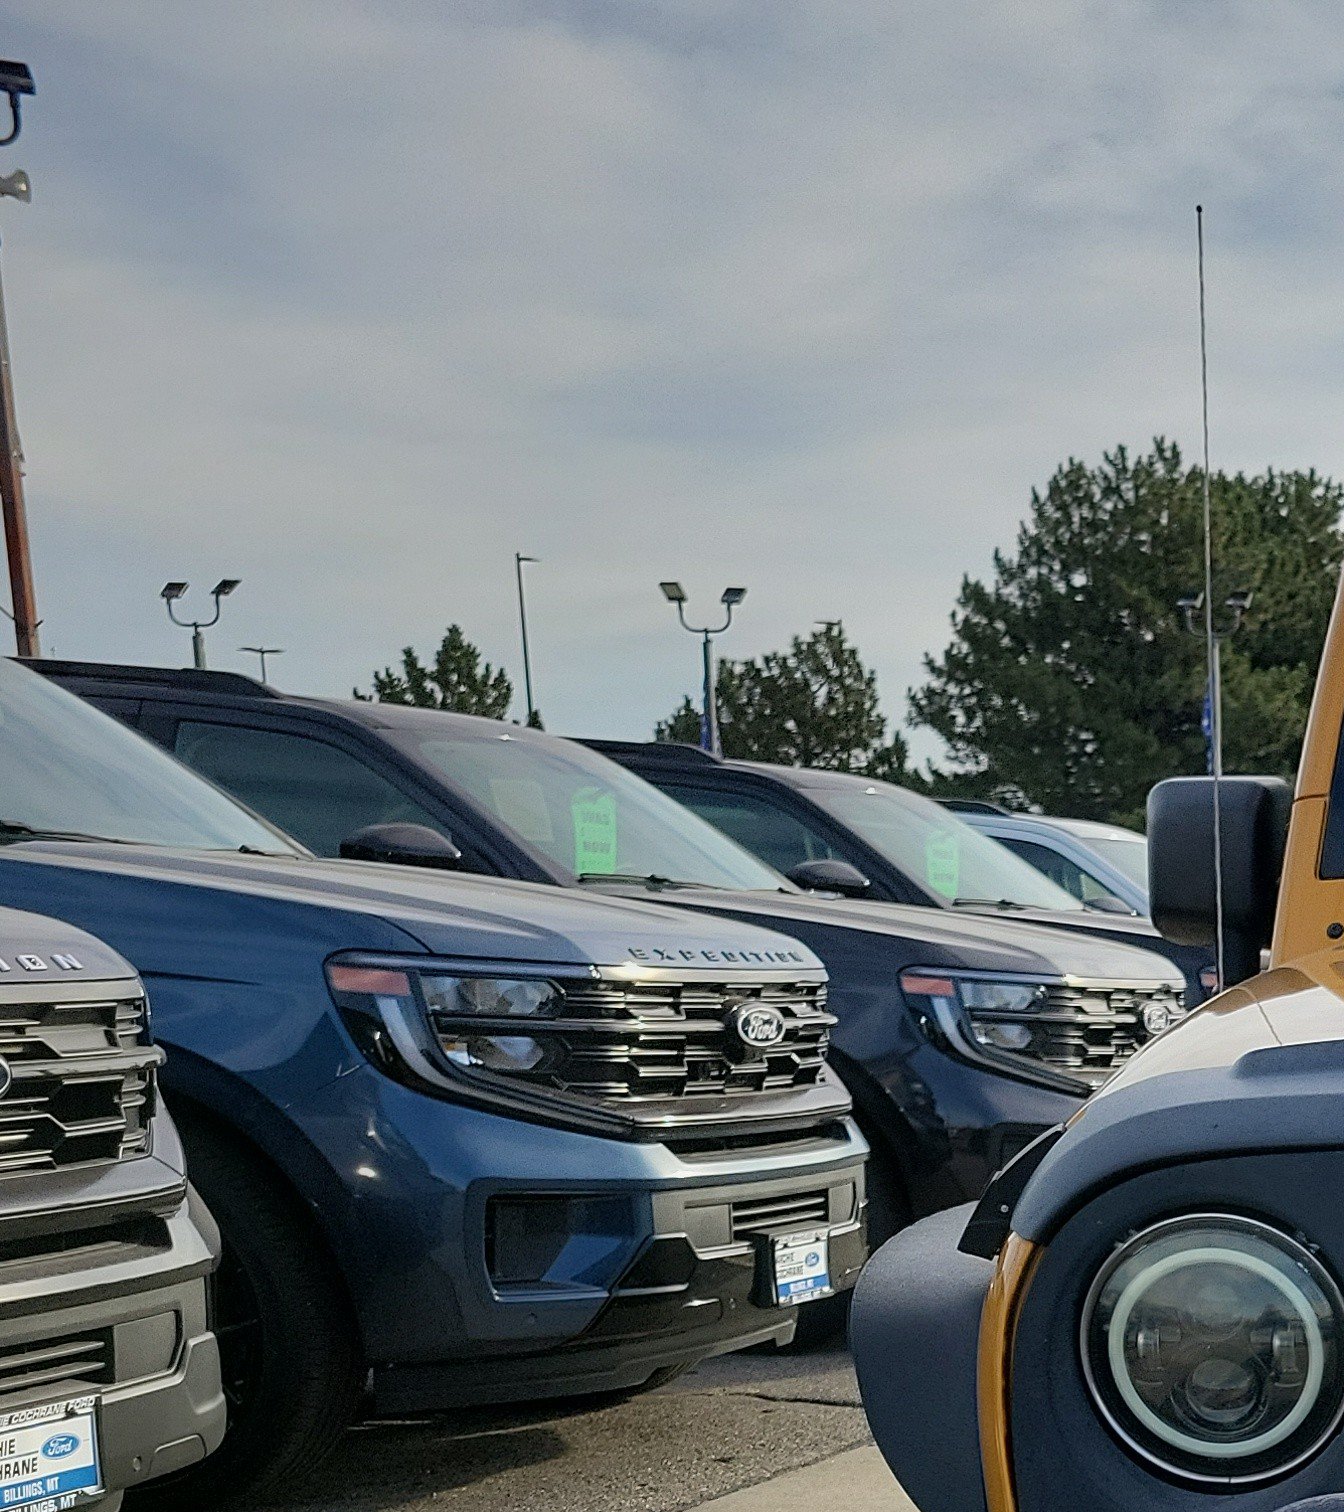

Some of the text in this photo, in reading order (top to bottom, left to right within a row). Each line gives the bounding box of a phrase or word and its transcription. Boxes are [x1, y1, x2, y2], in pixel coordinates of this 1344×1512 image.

[11, 1403, 67, 1424] COCHRANE
[67, 1397, 96, 1410] FORD
[4, 1477, 59, 1503] BILLINGS, MT
[60, 1494, 77, 1509] MT
